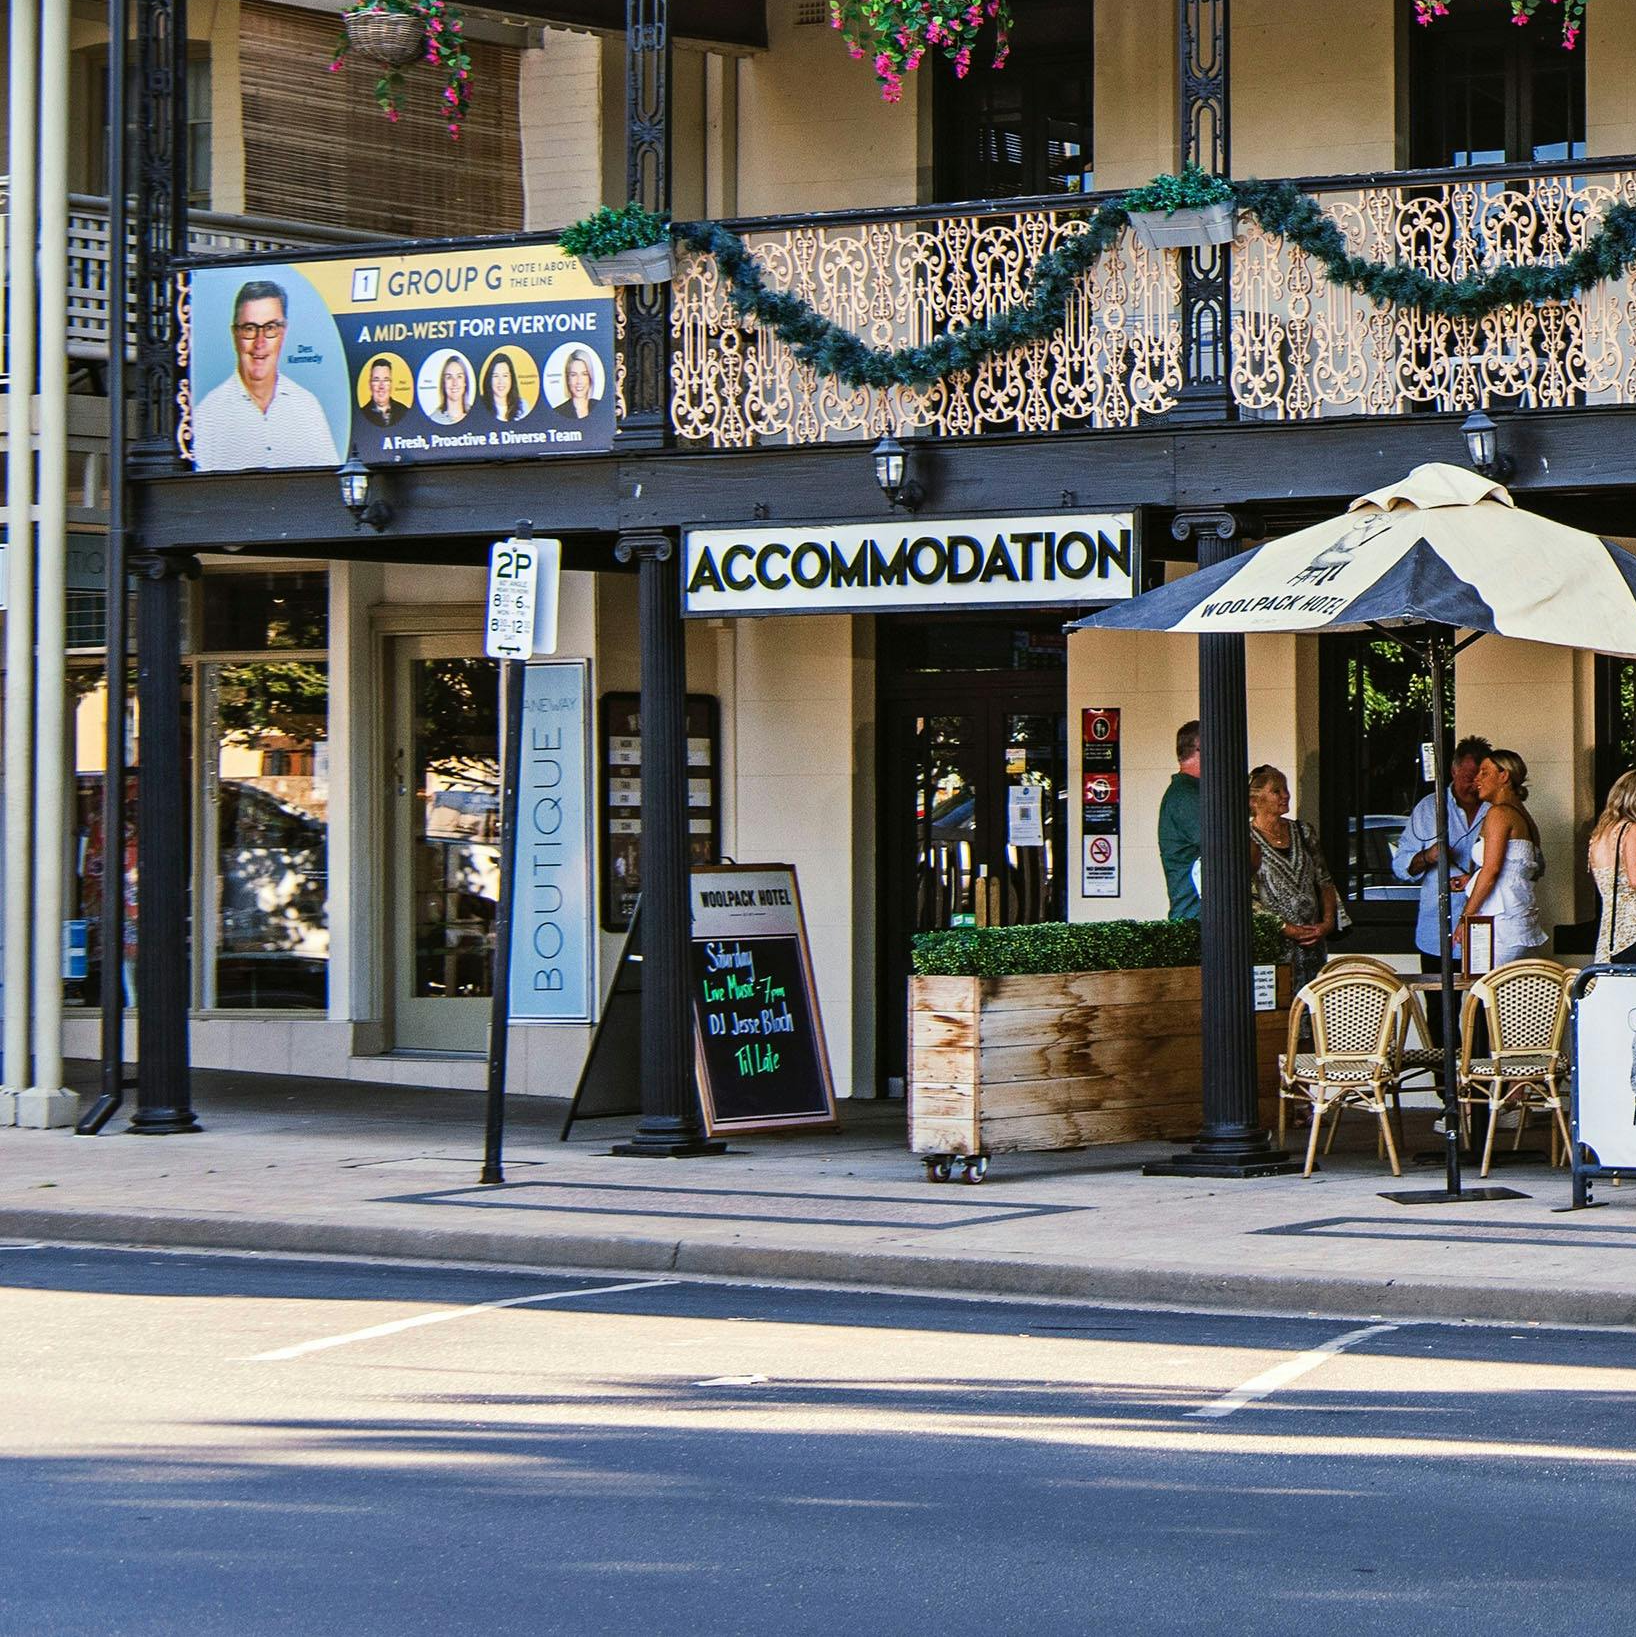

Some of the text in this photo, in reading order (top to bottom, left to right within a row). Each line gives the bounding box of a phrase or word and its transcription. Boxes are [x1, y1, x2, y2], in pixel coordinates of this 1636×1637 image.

[388, 265, 502, 296] GROUP G
[511, 263, 535, 273] VOTE
[544, 260, 577, 271] ABOVE
[510, 276, 553, 288] THE LINE
[358, 312, 597, 343] A MID-WEST FOR EVERYONE
[382, 429, 582, 451] A Fresh, Proactive & Diverse Team
[497, 552, 531, 579] 2P
[687, 529, 1131, 593] ACCOMMODATION
[1201, 595, 1347, 618] WOOLPACK HOTEL
[533, 727, 563, 991] BOUTIQUE
[700, 889, 792, 908] WOOLPACK HOTEL
[706, 942, 755, 981] Saturday
[704, 980, 725, 1003] Live
[727, 974, 754, 1000] Music
[708, 1013, 727, 1035] DJ
[731, 1012, 760, 1035] Jesse
[755, 1043, 780, 1073] Late
